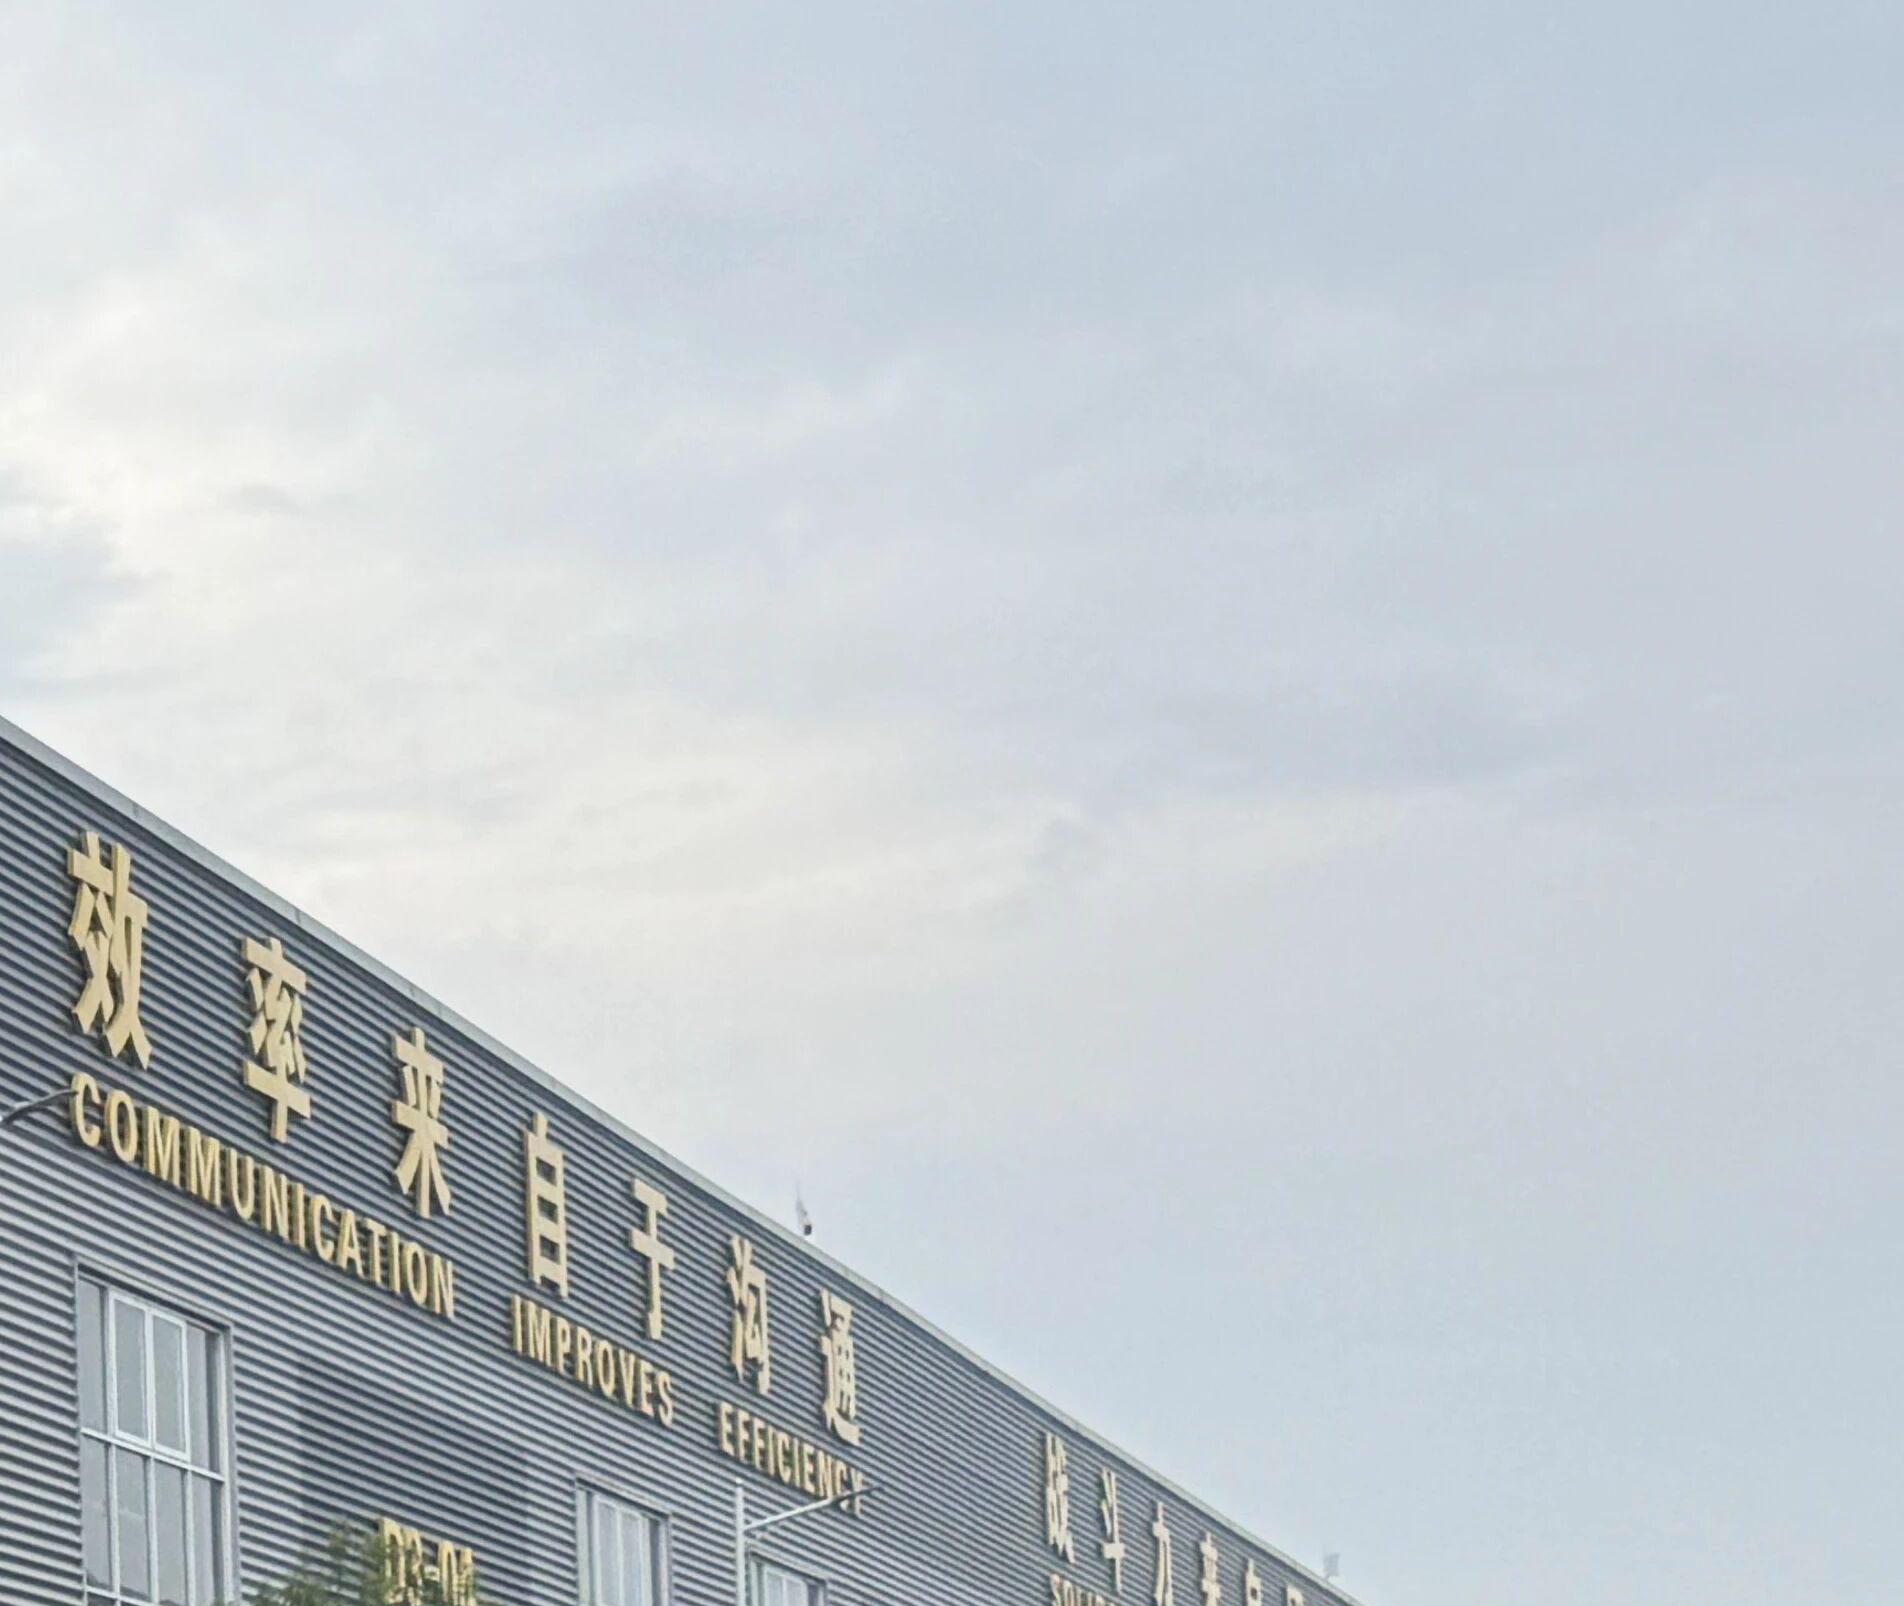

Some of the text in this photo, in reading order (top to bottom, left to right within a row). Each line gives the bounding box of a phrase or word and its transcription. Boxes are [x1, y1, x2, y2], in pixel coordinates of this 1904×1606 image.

[66, 829, 860, 1446] 效率来自于沟通
[70, 1073, 865, 1518] COMMUNICATION IMPROVES EFFICIENCY
